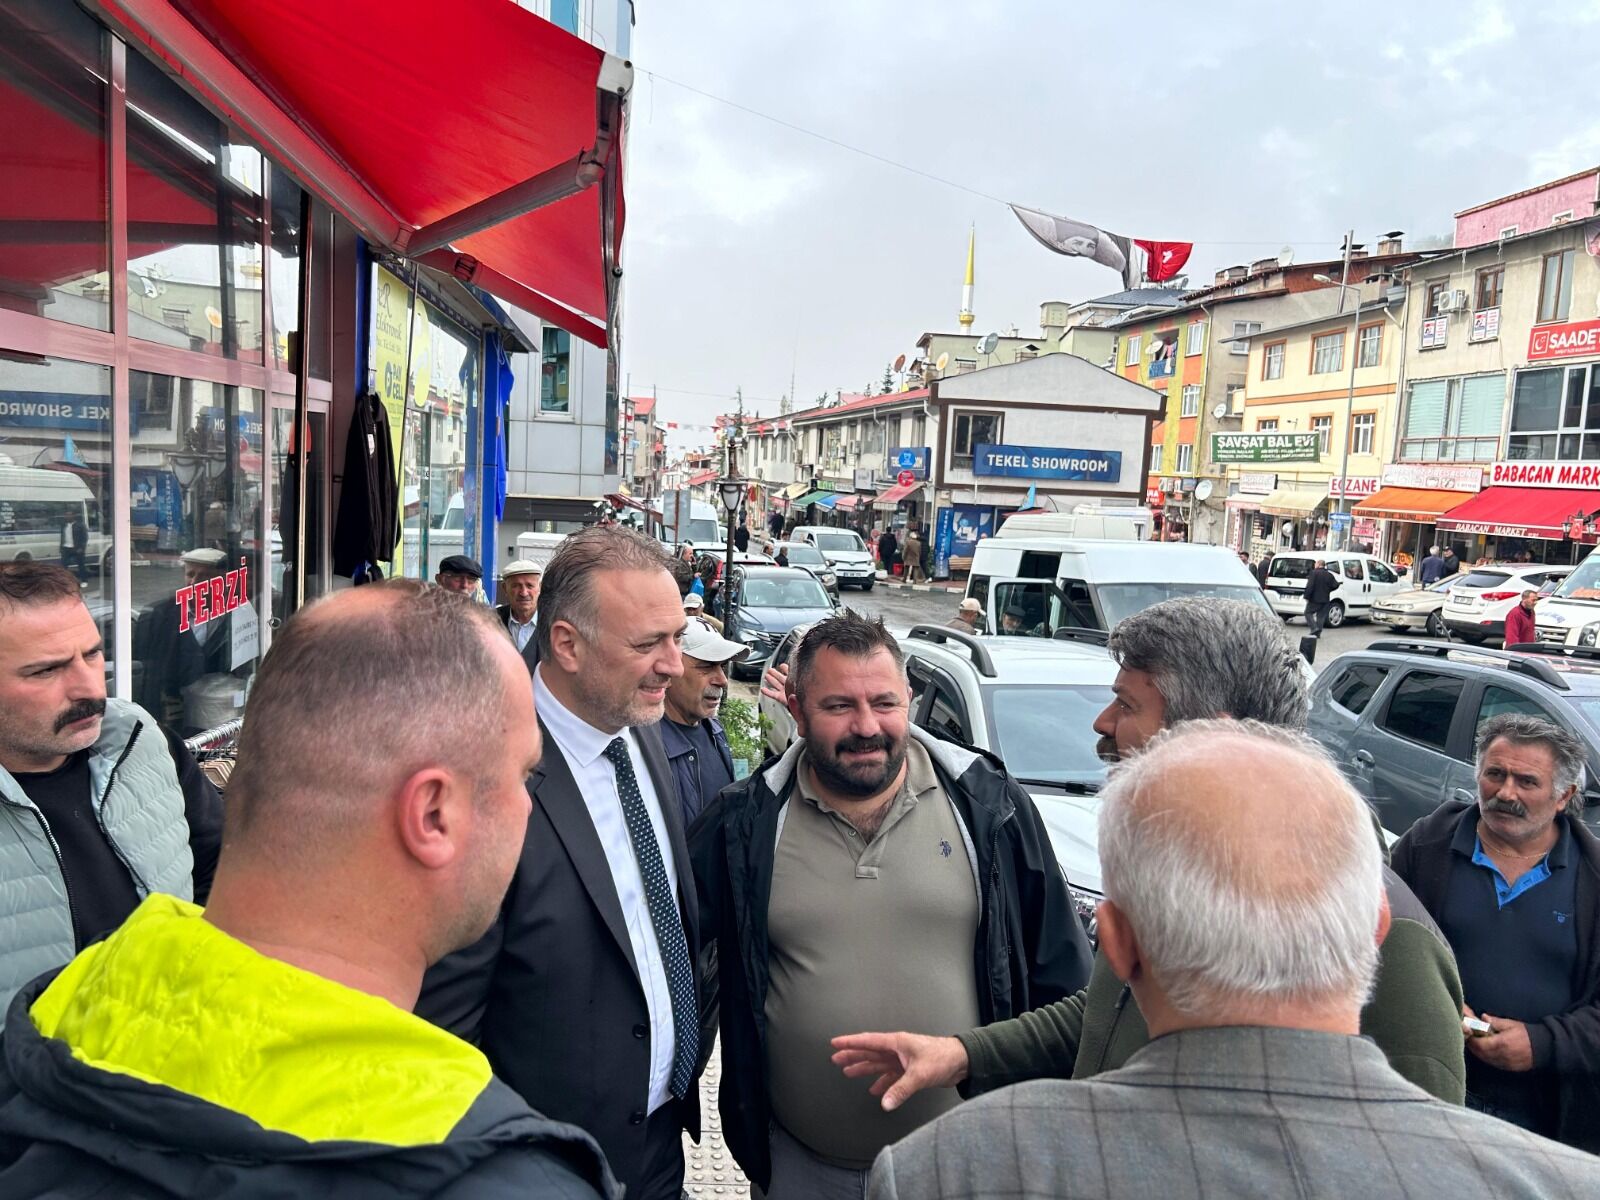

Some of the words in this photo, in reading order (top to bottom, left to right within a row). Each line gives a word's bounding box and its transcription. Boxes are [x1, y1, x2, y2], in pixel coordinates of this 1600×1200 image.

[1549, 328, 1600, 348] SAADE
[1217, 436, 1265, 449] ŞAVŞAT
[1267, 436, 1292, 448] BAL
[987, 453, 1029, 468] TEKEL
[1031, 456, 1108, 472] SHOWROOM
[1493, 465, 1554, 484] BABACAN
[1557, 466, 1600, 486] MARK
[1455, 523, 1489, 533] BABACAN
[1494, 525, 1527, 537] MARKET
[176, 556, 247, 633] TERZİ
